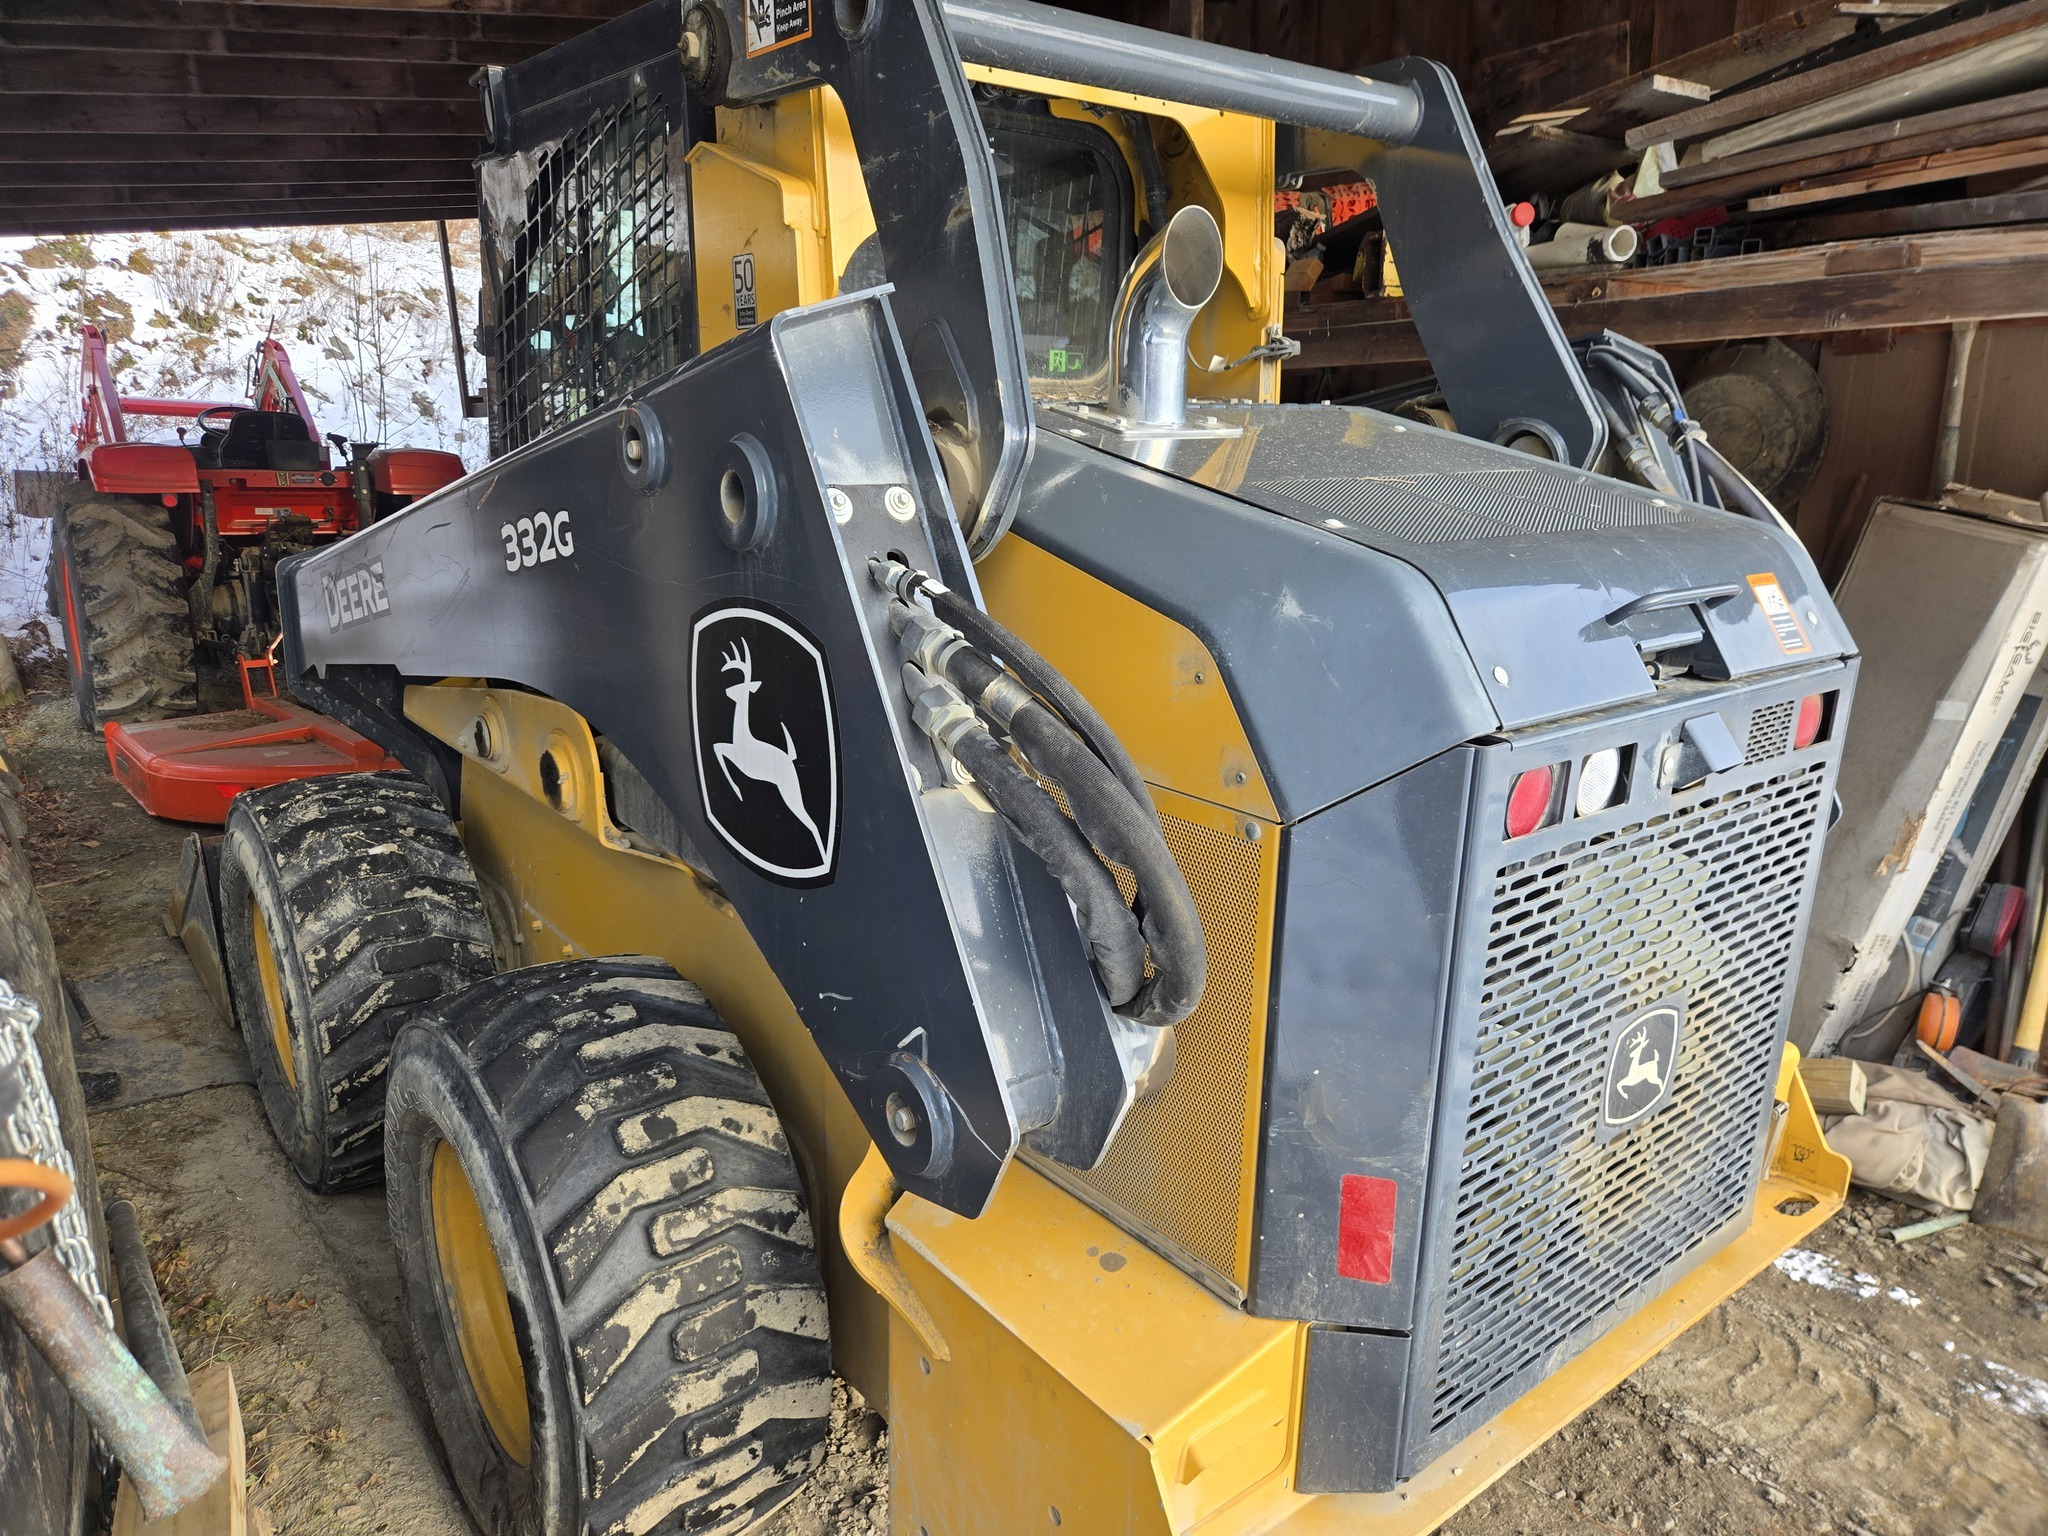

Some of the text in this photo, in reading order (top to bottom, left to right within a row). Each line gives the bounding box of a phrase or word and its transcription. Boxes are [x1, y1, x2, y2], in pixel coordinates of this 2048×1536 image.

[776, 0, 807, 19] Pinch Area
[776, 18, 803, 33] Keep Away
[734, 258, 754, 294] 50
[736, 293, 755, 307] YEARS
[501, 510, 575, 573] 332G
[322, 561, 390, 629] DEERE
[1991, 611, 2042, 708] BIG GAME
